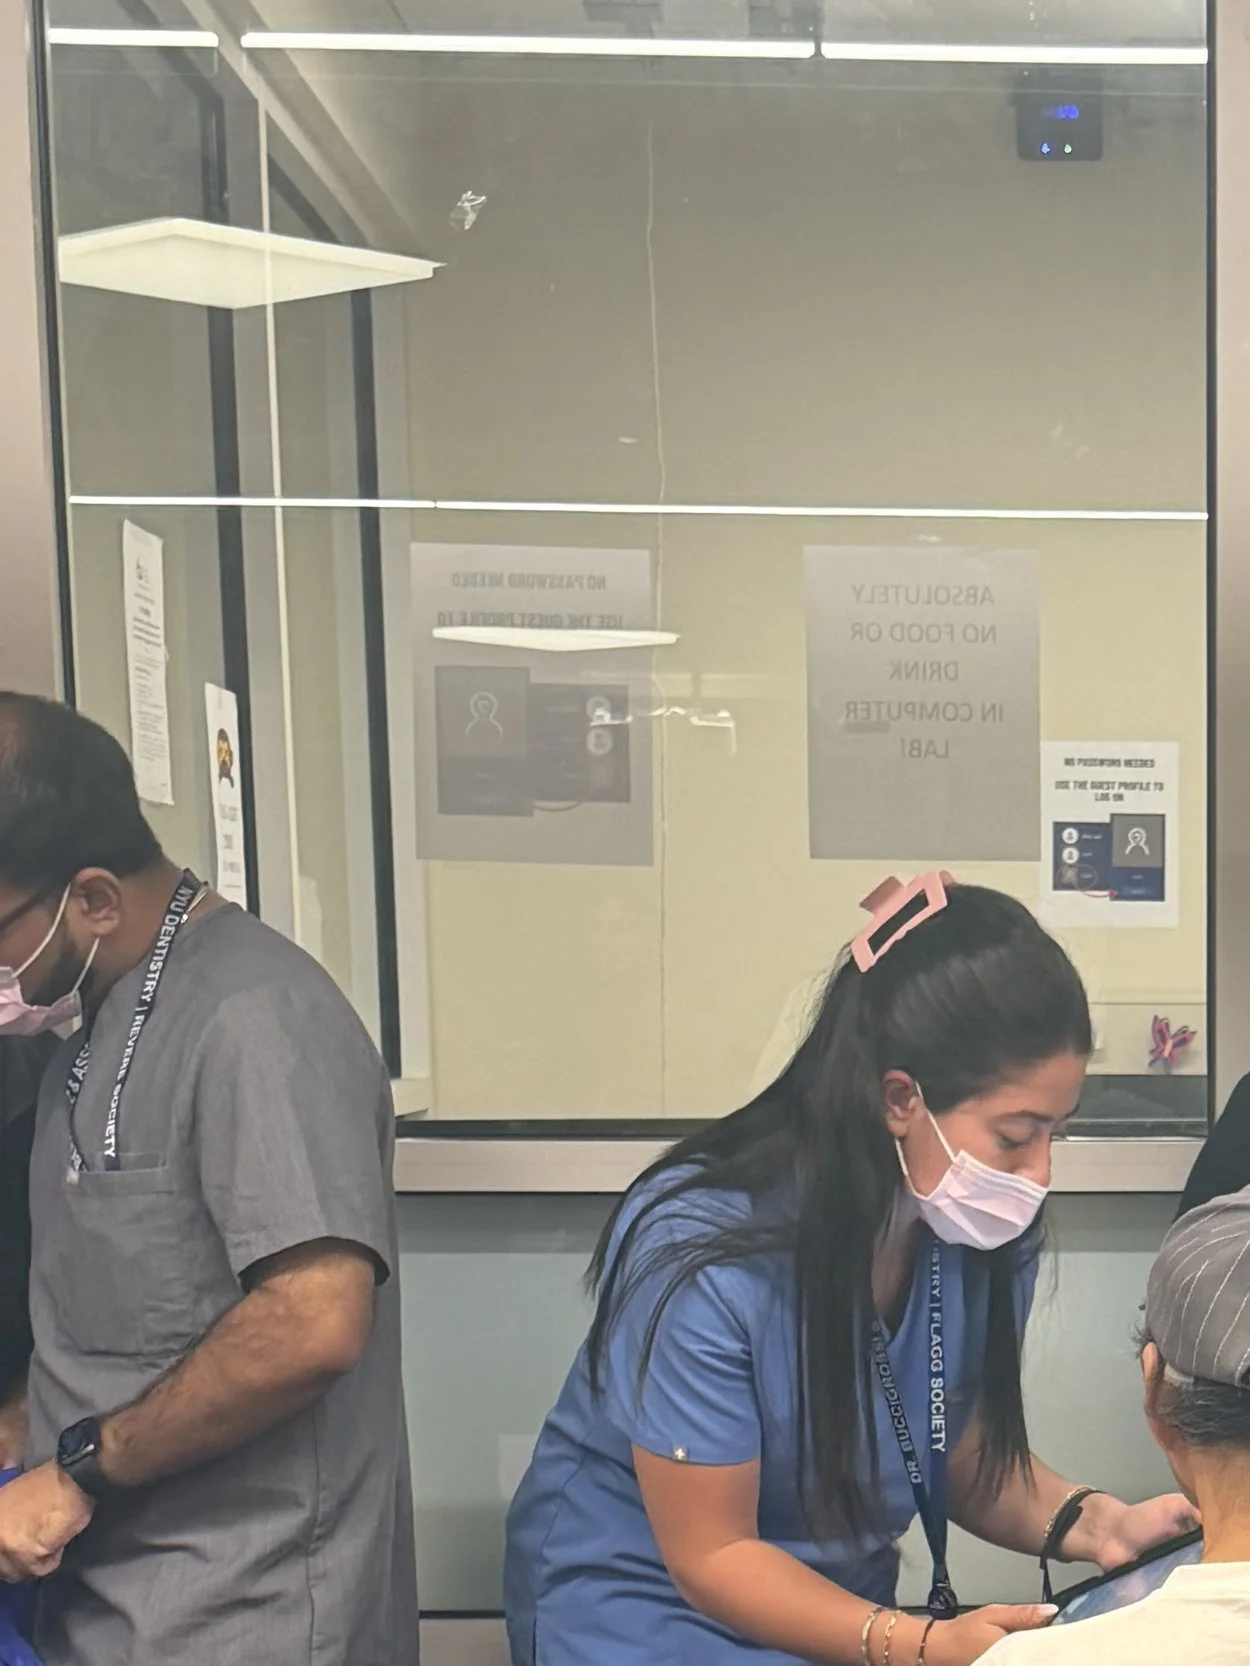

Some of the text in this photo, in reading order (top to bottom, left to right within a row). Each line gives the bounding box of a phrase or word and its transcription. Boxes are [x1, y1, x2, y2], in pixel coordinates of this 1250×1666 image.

[139, 913, 181, 1003] DENTISTRY
[116, 1013, 145, 1082] REVERE
[103, 1080, 123, 1158] SOCIETY
[928, 1312, 943, 1372] FLAGG
[929, 1377, 946, 1453] SOCIETY
